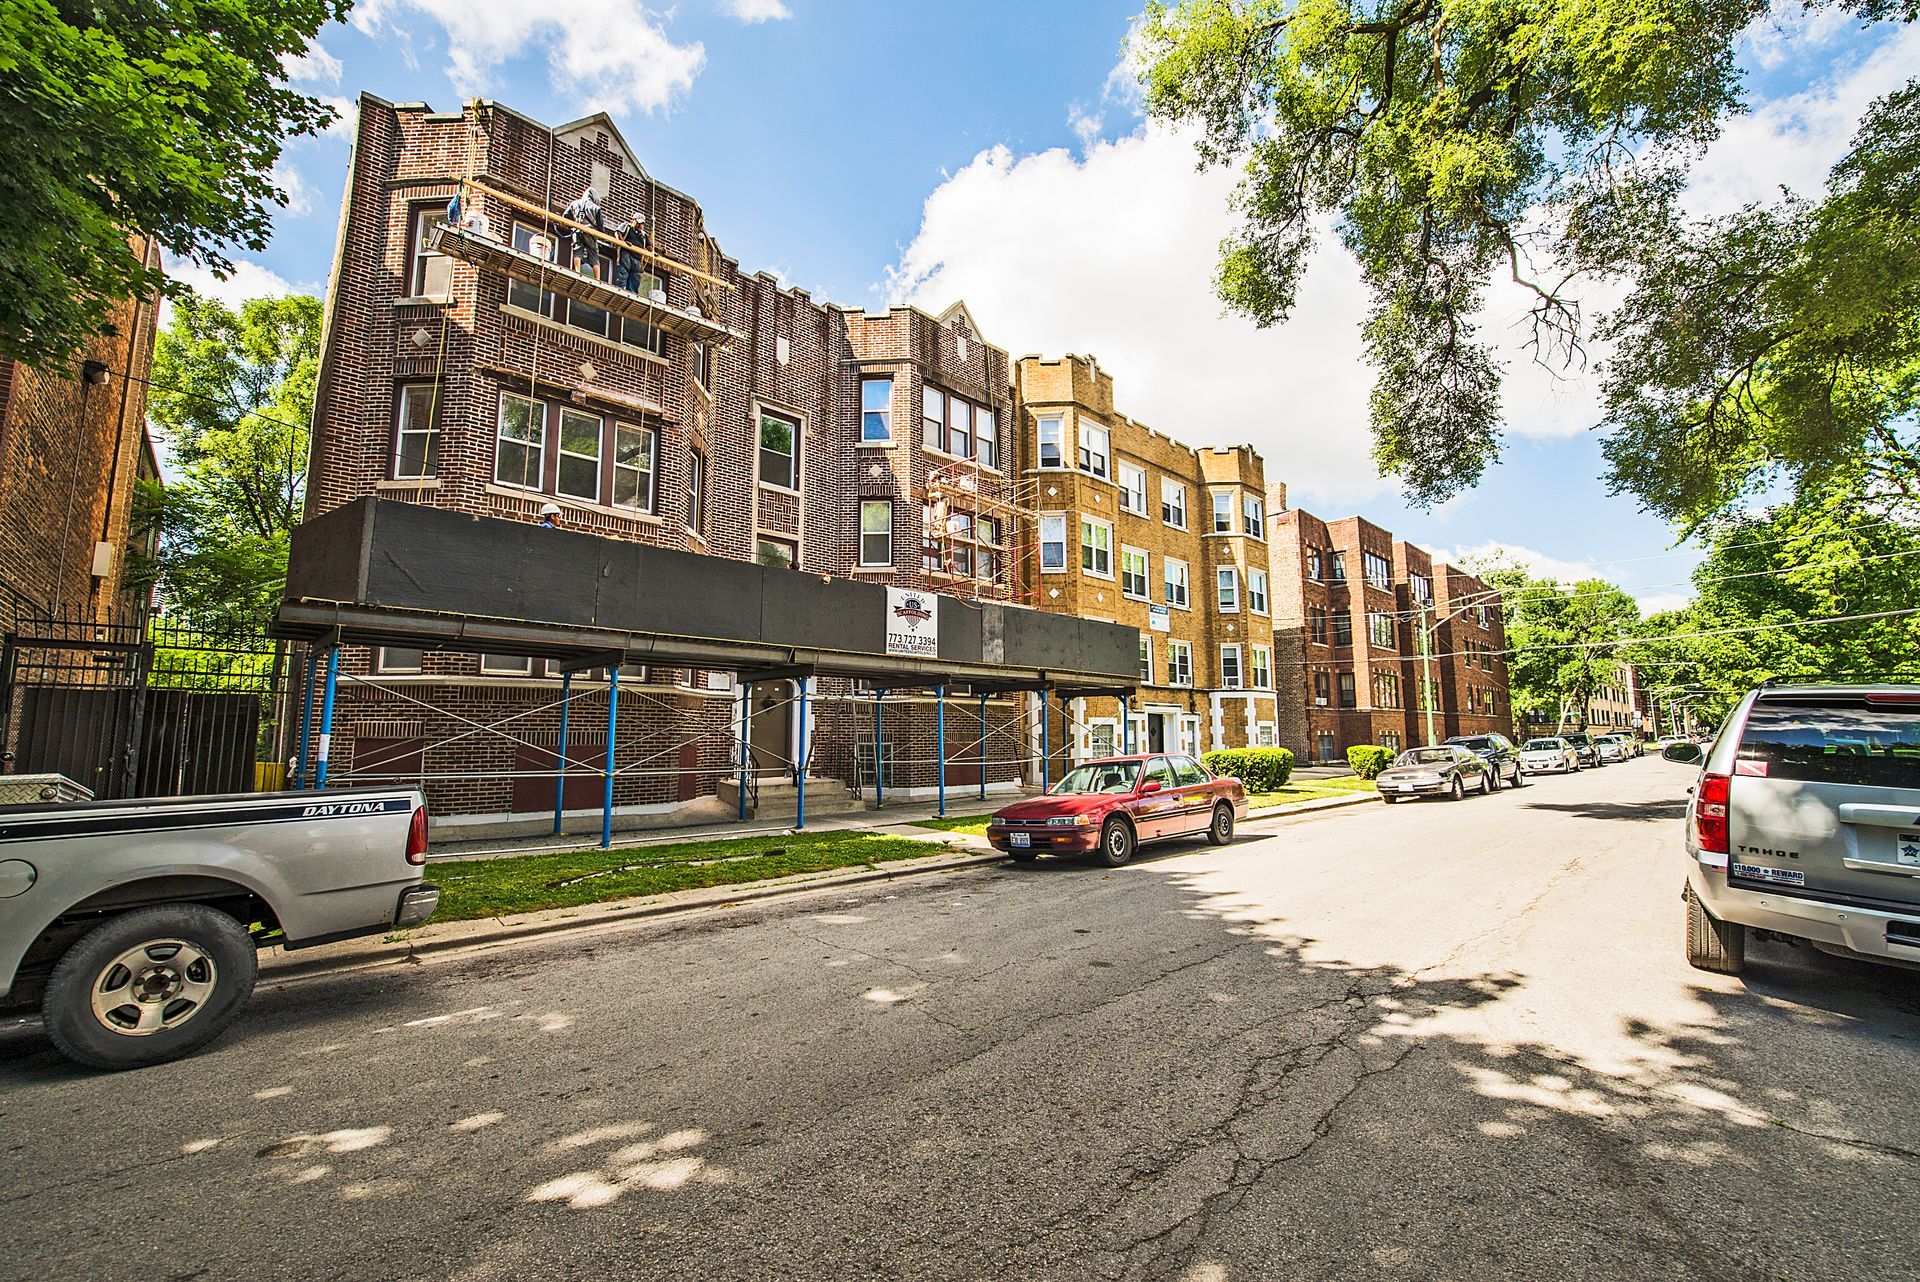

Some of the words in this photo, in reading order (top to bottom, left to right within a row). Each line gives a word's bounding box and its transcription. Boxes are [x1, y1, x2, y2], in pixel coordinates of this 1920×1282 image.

[910, 645, 936, 653] SERVICES
[302, 802, 385, 817] DAYTONA
[1737, 845, 1800, 859] TAHOE
[1771, 869, 1804, 879] REWARD
